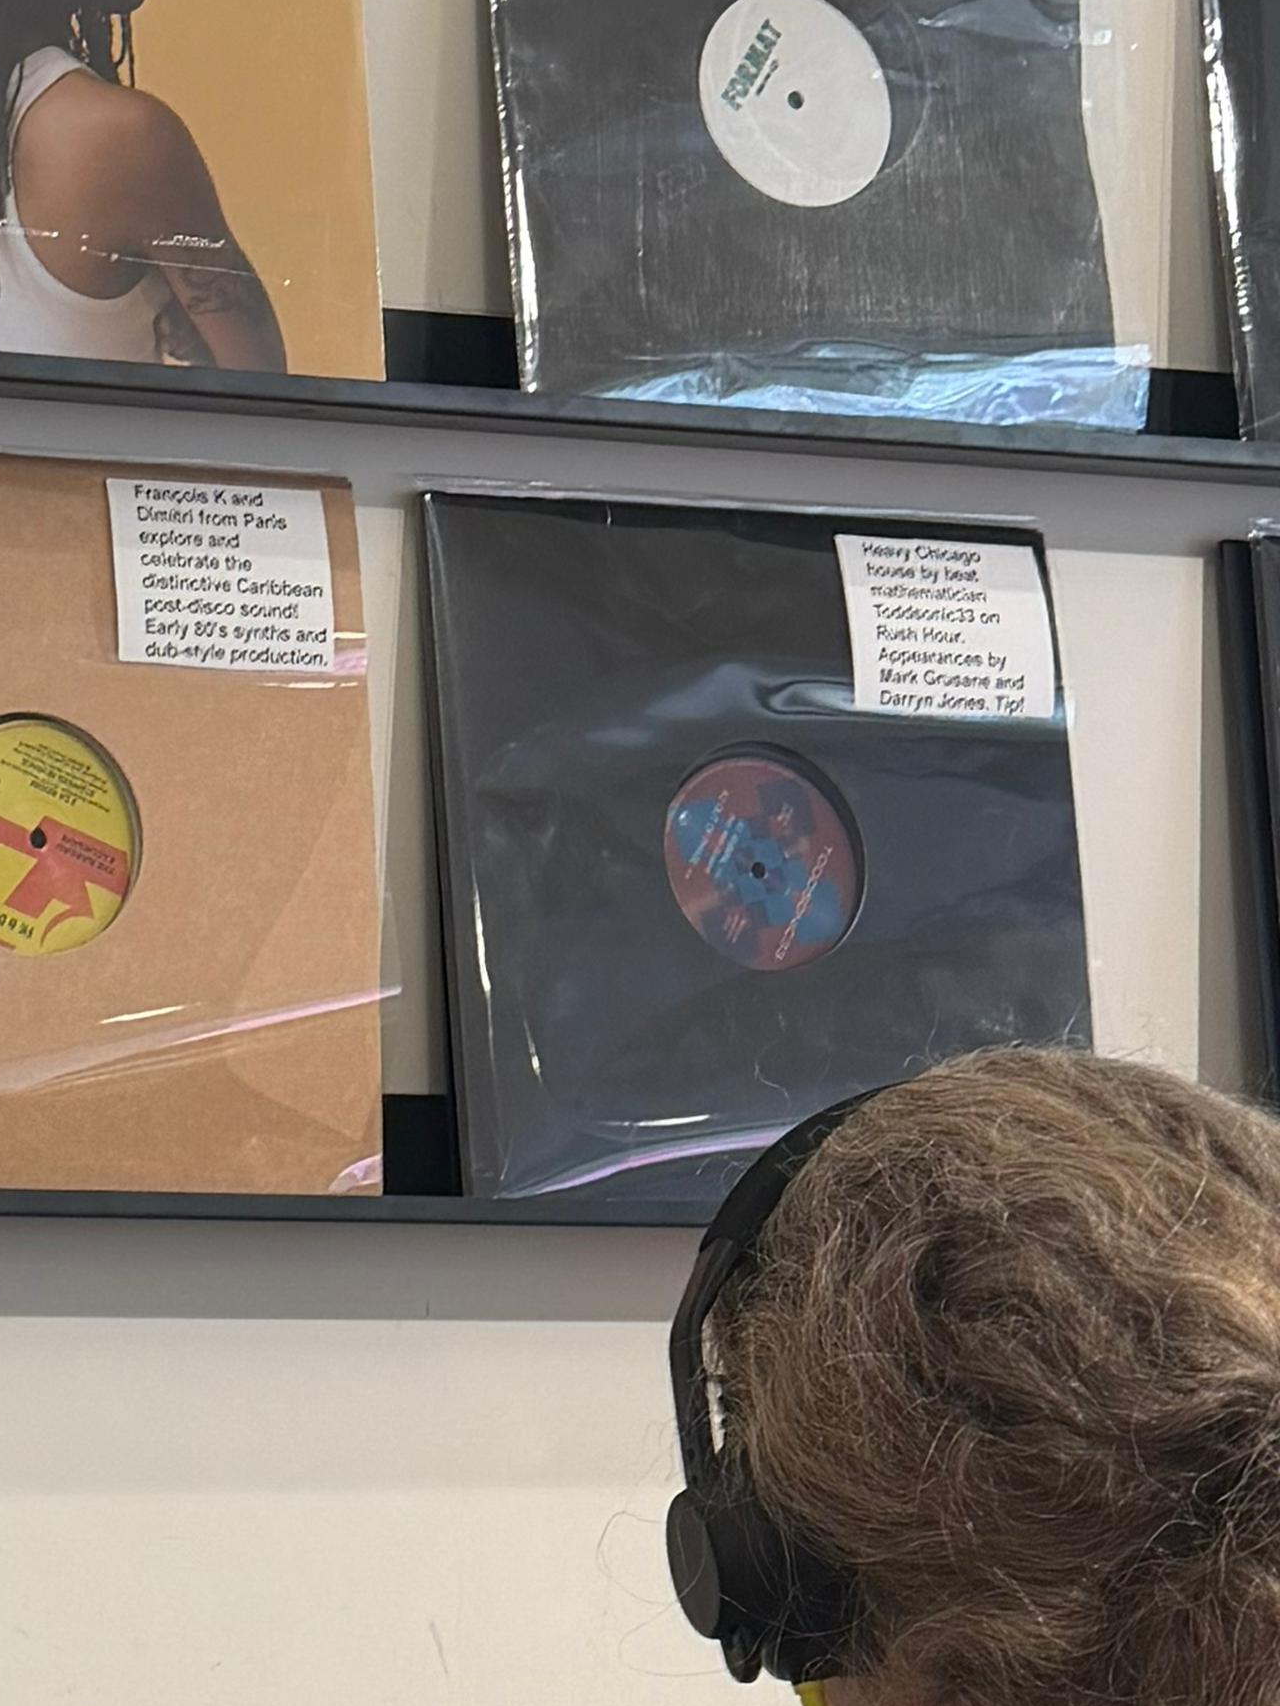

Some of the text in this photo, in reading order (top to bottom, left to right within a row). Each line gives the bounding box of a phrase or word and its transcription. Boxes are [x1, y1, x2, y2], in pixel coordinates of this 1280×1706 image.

[721, 19, 782, 111] FORMAT
[214, 489, 227, 505] K
[232, 492, 263, 507] and
[137, 506, 287, 530] Dimitri from Paris
[139, 531, 240, 548] explore and
[140, 552, 252, 571] celebrate the
[915, 544, 981, 566] Chicago
[867, 562, 915, 579] house
[920, 566, 939, 583] by
[142, 573, 323, 597] distinctive Caribbean
[870, 585, 987, 603] mathematician
[144, 596, 299, 618] post-disco sound!
[981, 611, 1000, 623] on
[145, 618, 189, 638] Early
[233, 626, 290, 644] synths
[296, 628, 327, 643] and
[876, 625, 965, 644] Rush Hour.
[145, 641, 328, 668] dub-style production.
[879, 647, 1007, 671] Appearances by
[880, 668, 918, 684] Mark
[996, 675, 1024, 690] and
[996, 695, 1024, 714] Tip!
